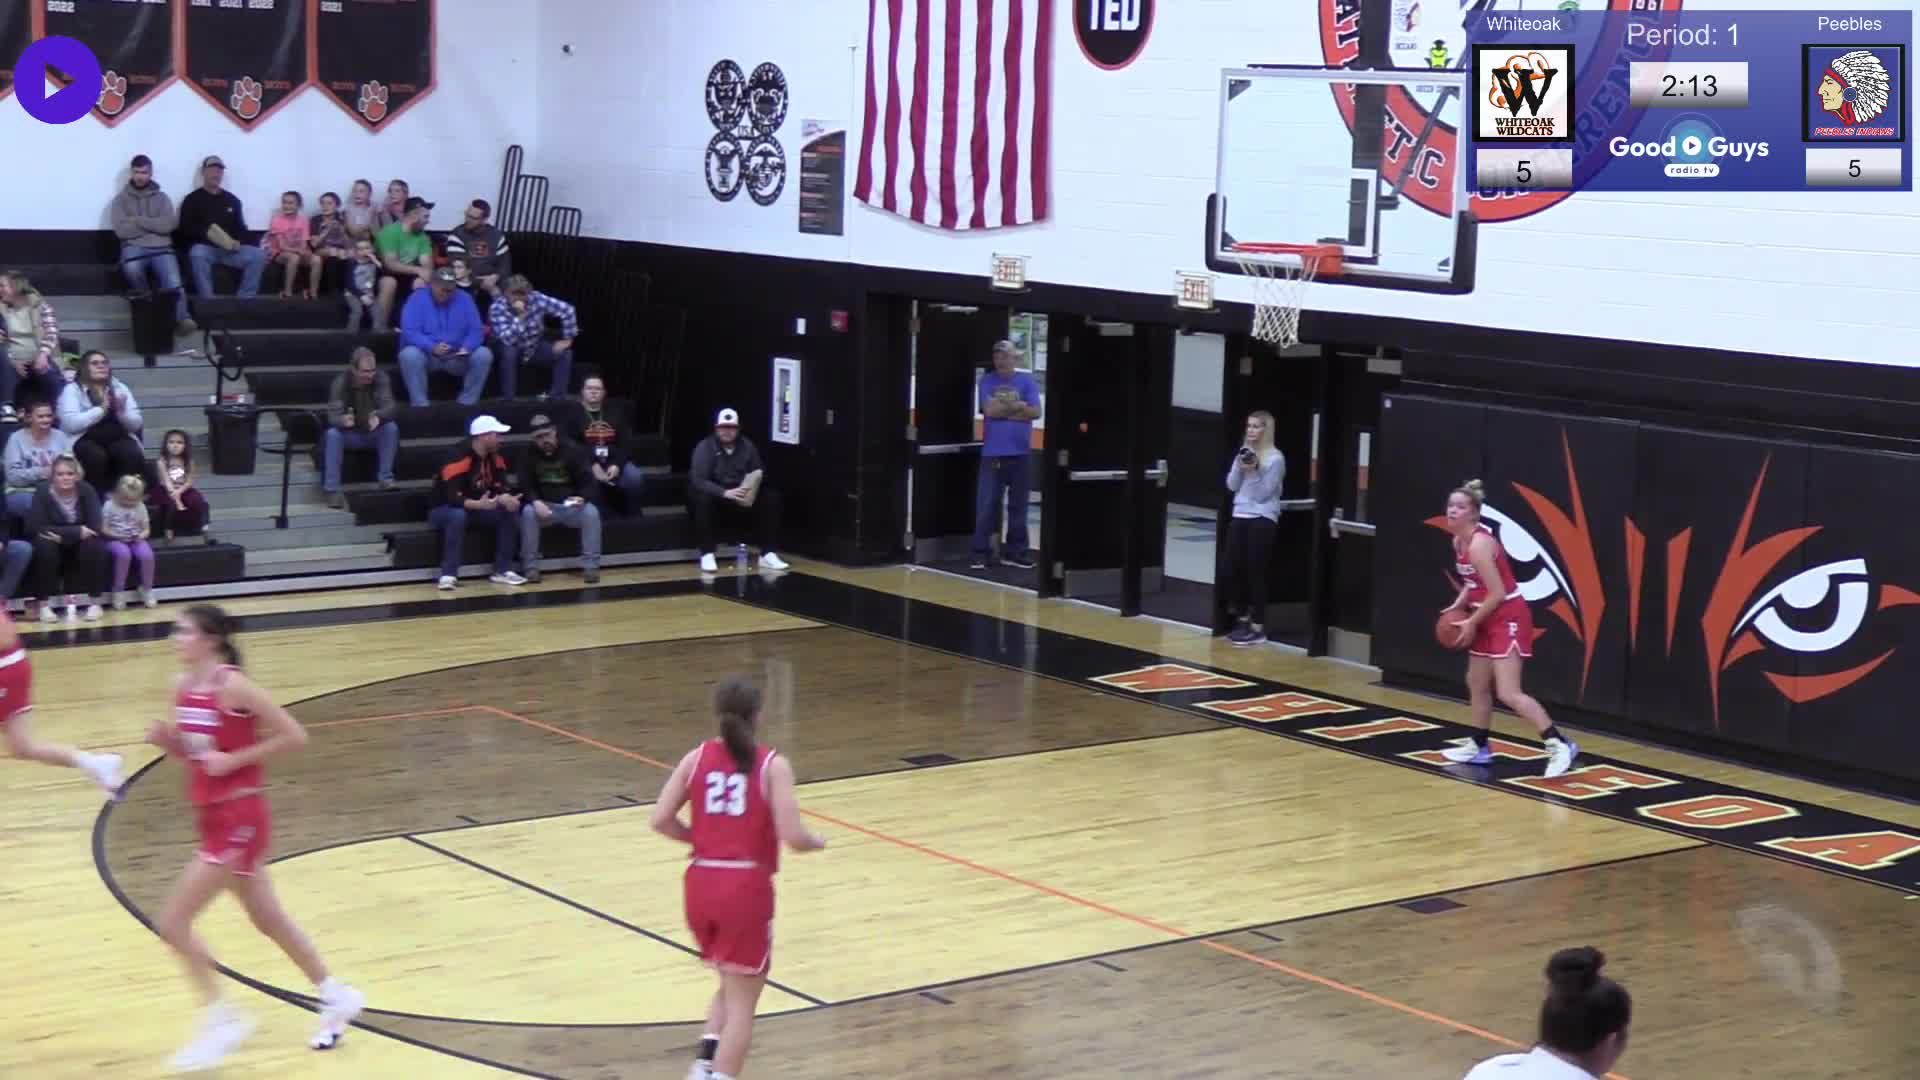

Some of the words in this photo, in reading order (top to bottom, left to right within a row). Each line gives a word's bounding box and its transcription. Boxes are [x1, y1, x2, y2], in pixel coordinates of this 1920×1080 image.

[1184, 278, 1206, 301] EXIT
[1090, 663, 1920, 872] WHITEOA
[704, 770, 748, 816] 23
